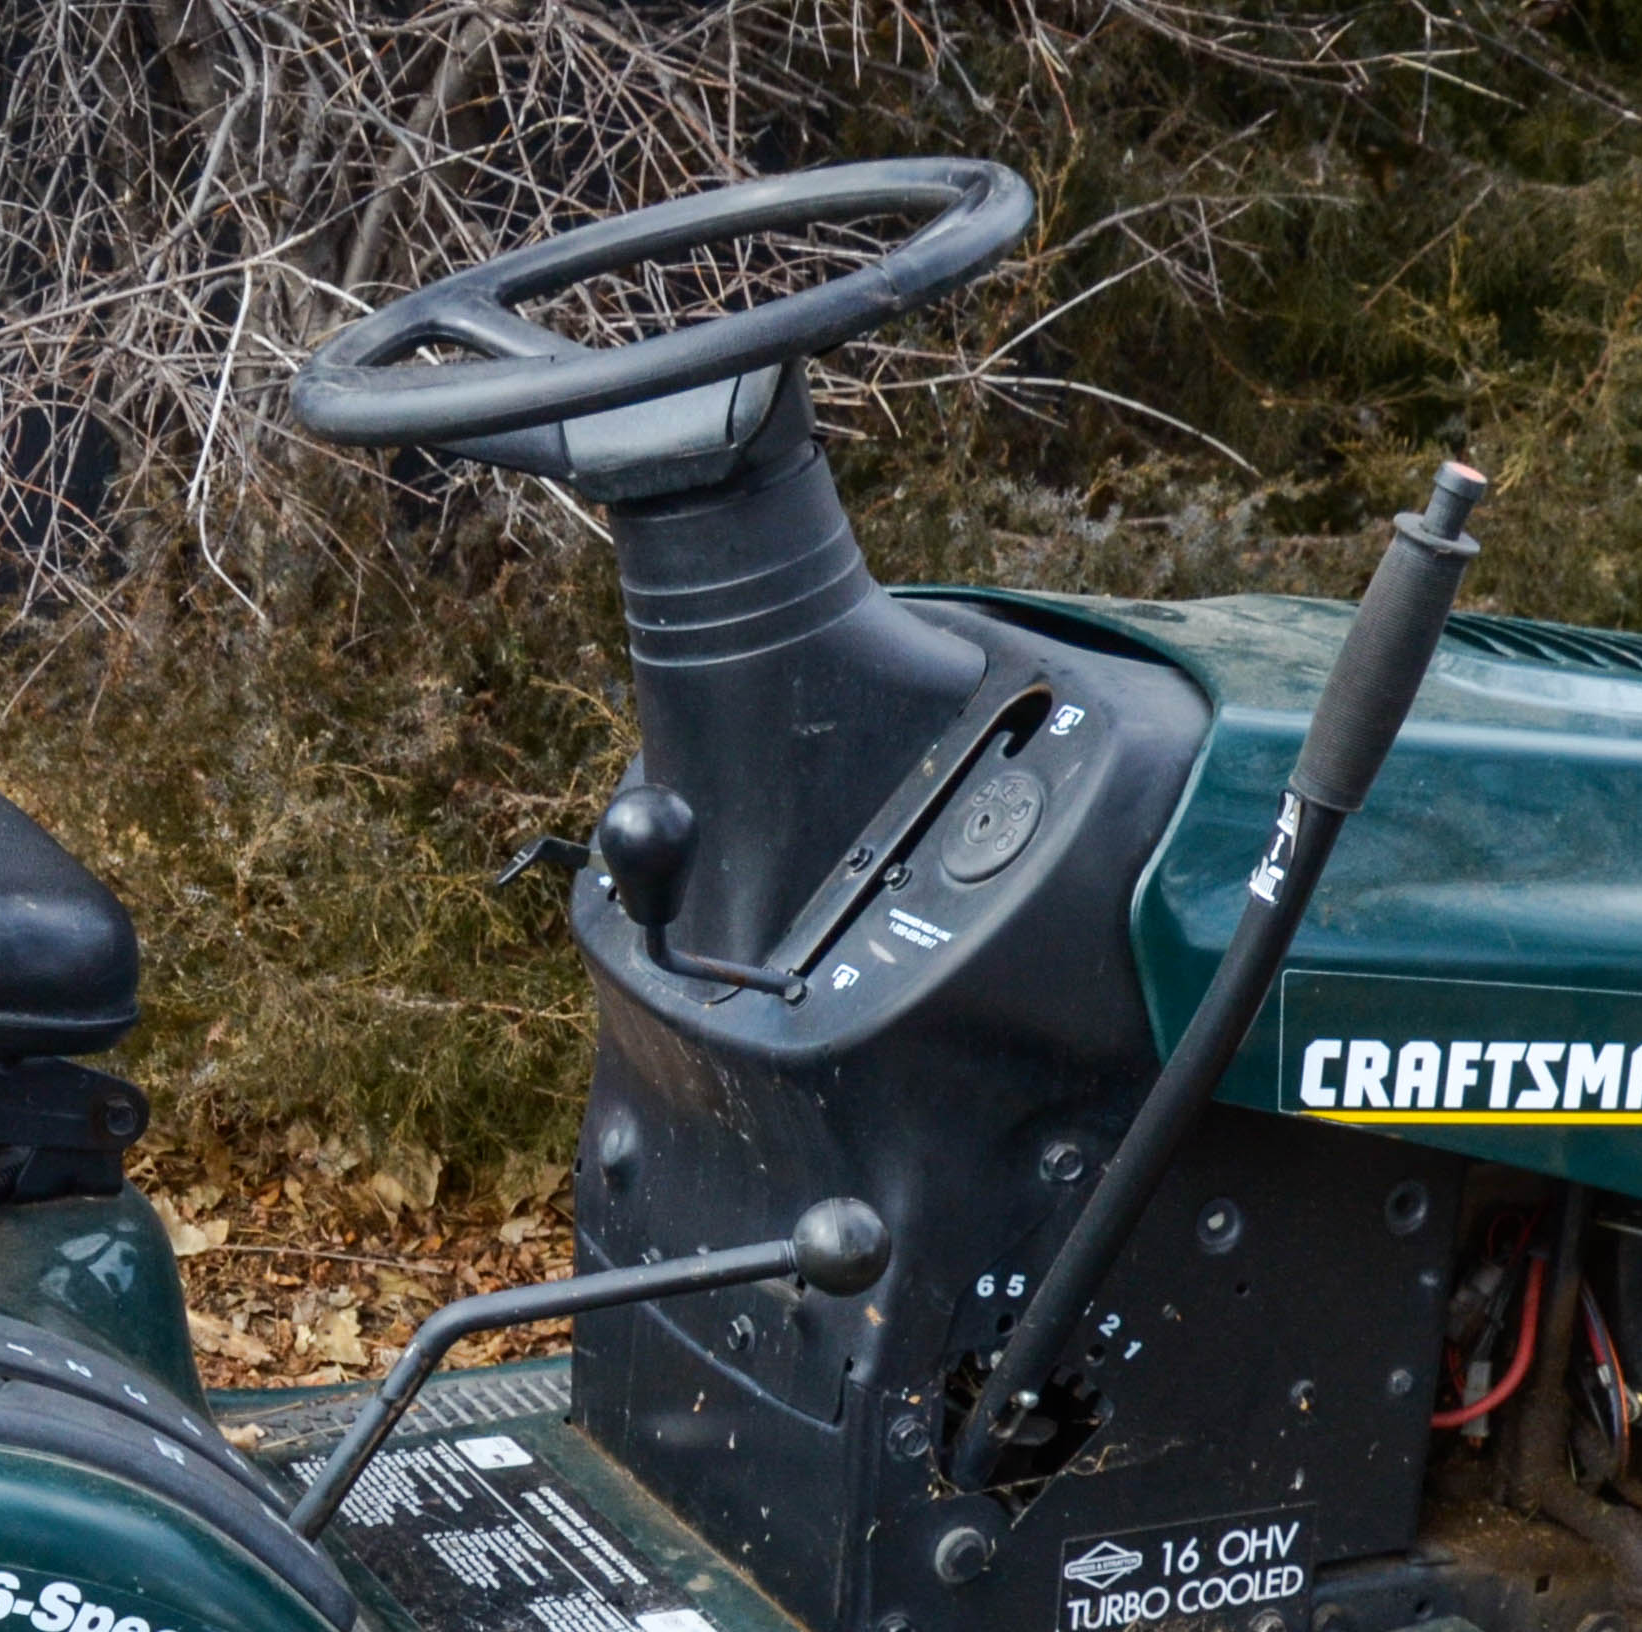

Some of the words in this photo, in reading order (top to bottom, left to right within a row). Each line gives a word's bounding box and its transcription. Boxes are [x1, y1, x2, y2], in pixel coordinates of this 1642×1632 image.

[977, 1274, 995, 1297] 6
[1006, 1274, 1026, 1297] 5
[1099, 1314, 1121, 1338] 2
[1123, 1341, 1143, 1360] 1
[1162, 1537, 1200, 1577] 16
[1218, 1521, 1300, 1567] OHV
[1067, 1586, 1171, 1631] TURBO
[1177, 1565, 1304, 1614] COOLED
